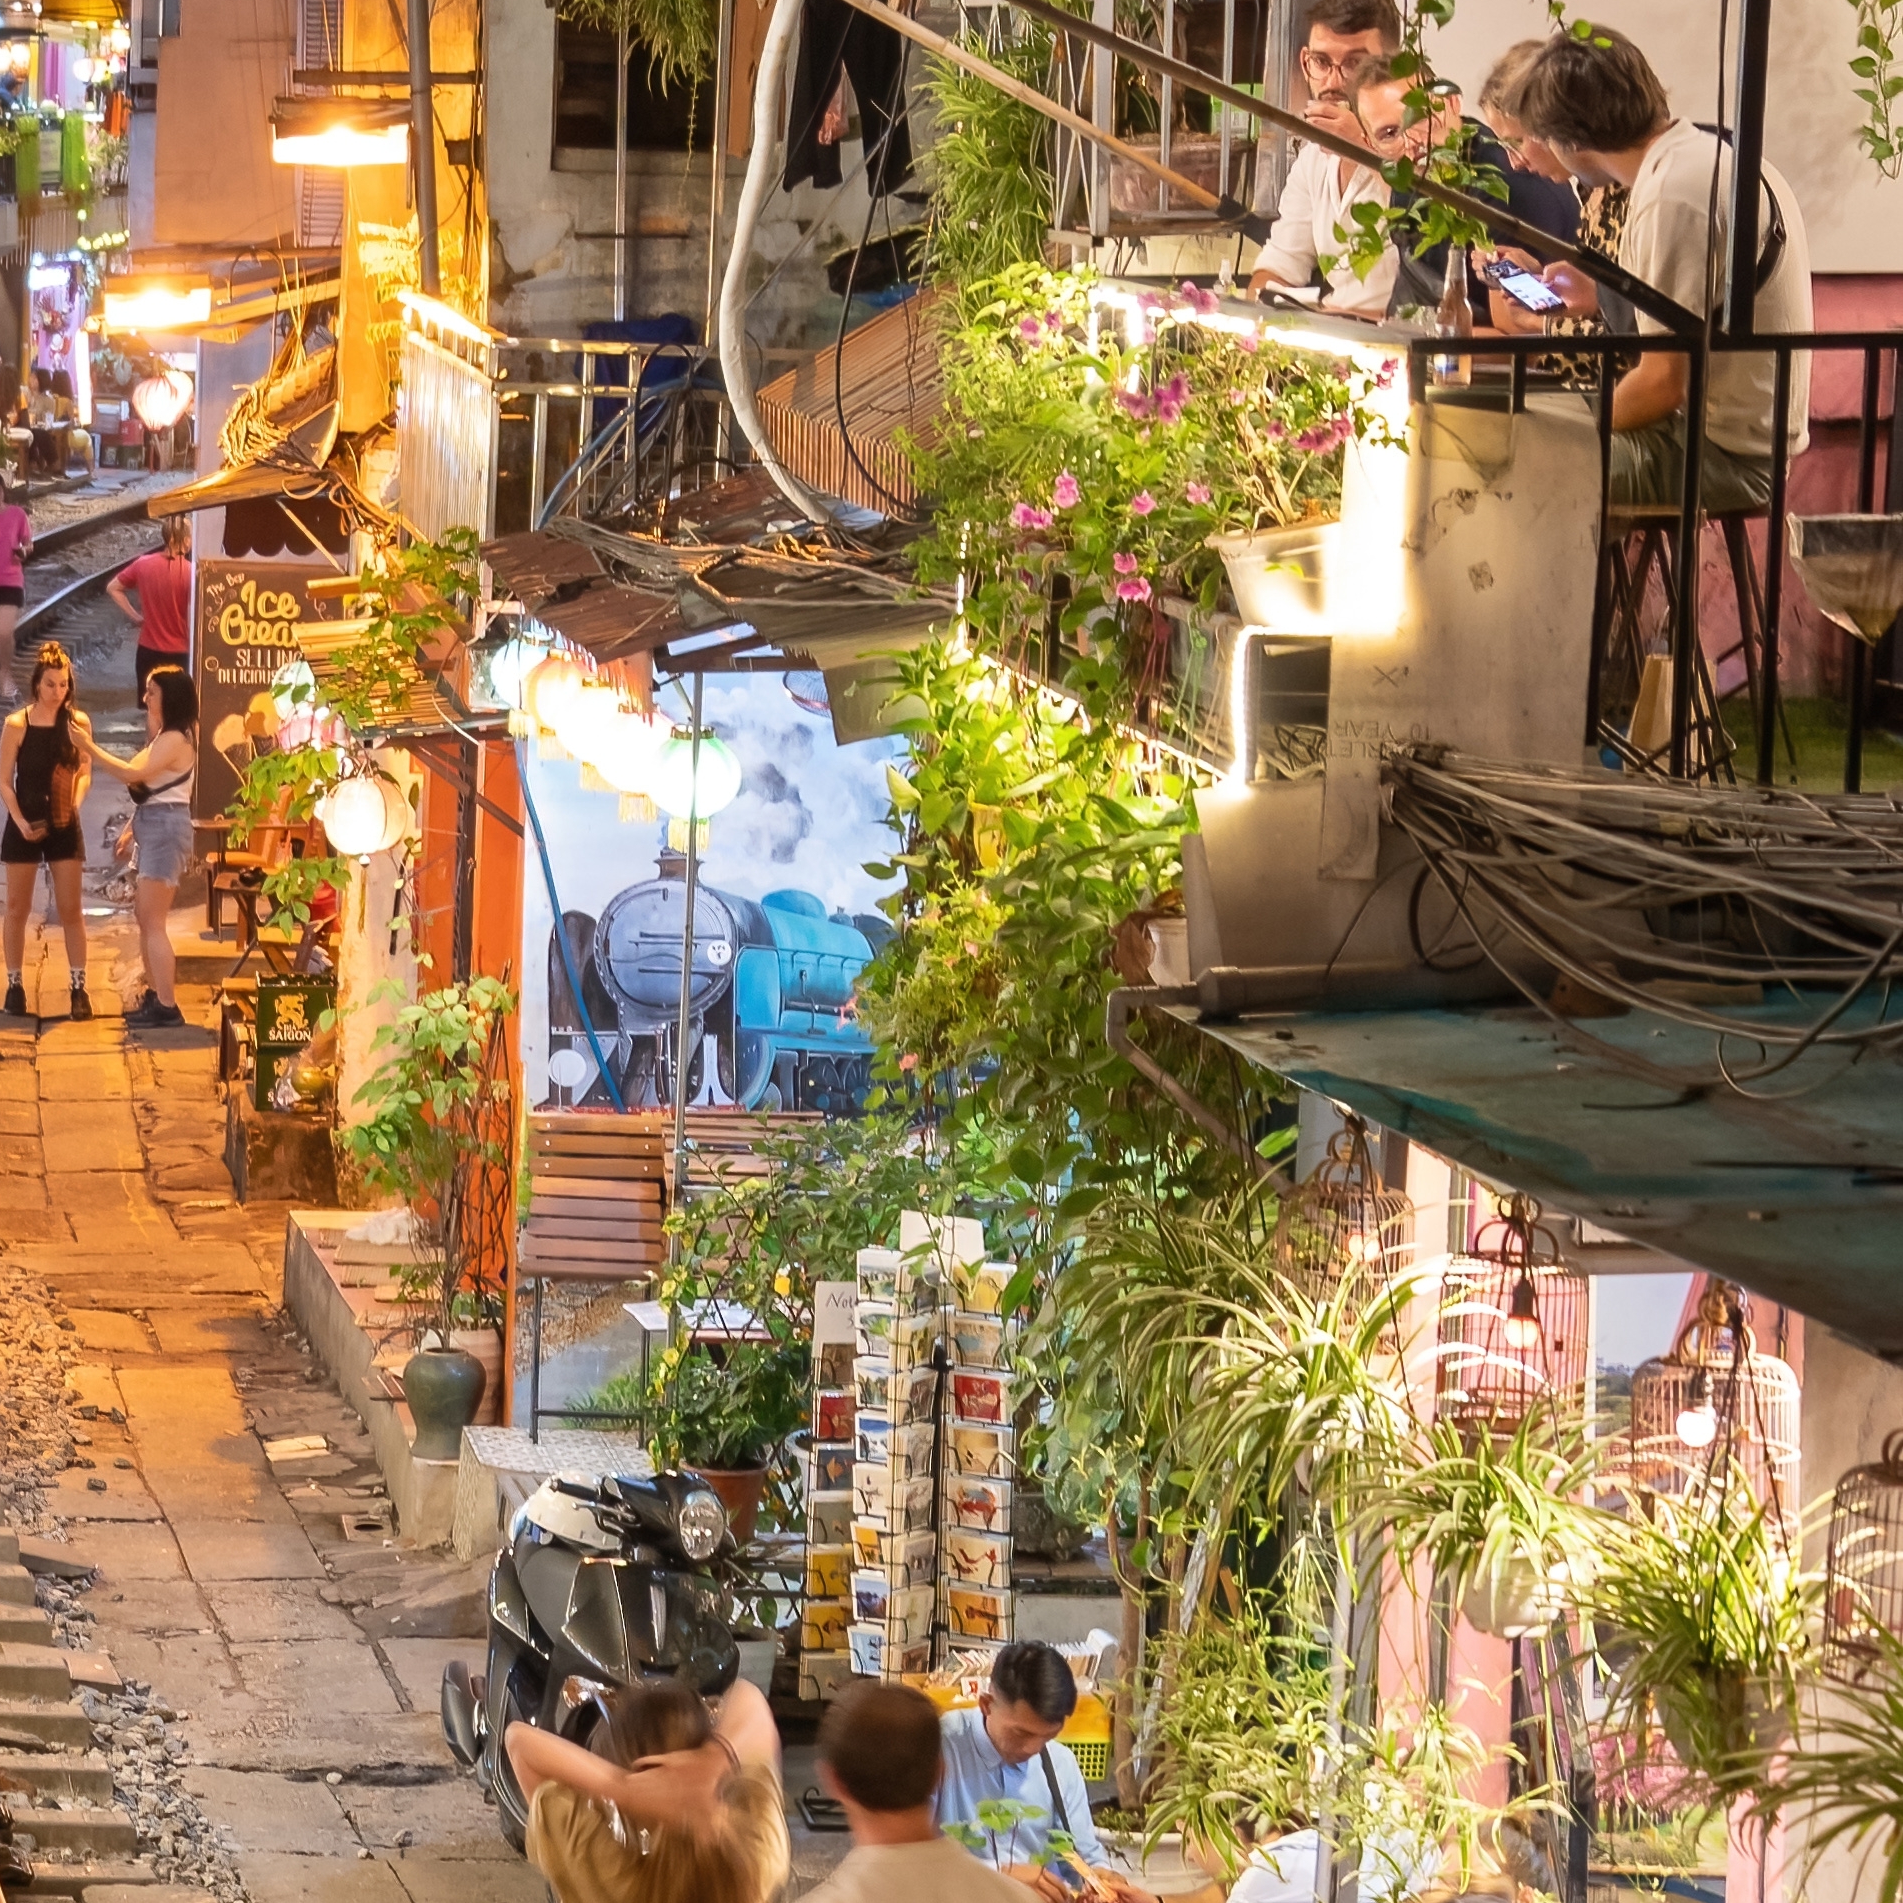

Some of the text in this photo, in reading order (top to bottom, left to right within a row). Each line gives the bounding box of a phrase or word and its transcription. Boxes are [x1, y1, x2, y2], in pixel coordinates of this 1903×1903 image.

[206, 582, 226, 598] The
[240, 580, 301, 619] Ice
[220, 603, 297, 648] Crea
[268, 1028, 311, 1041] SAIGON
[825, 1291, 854, 1309] Not
